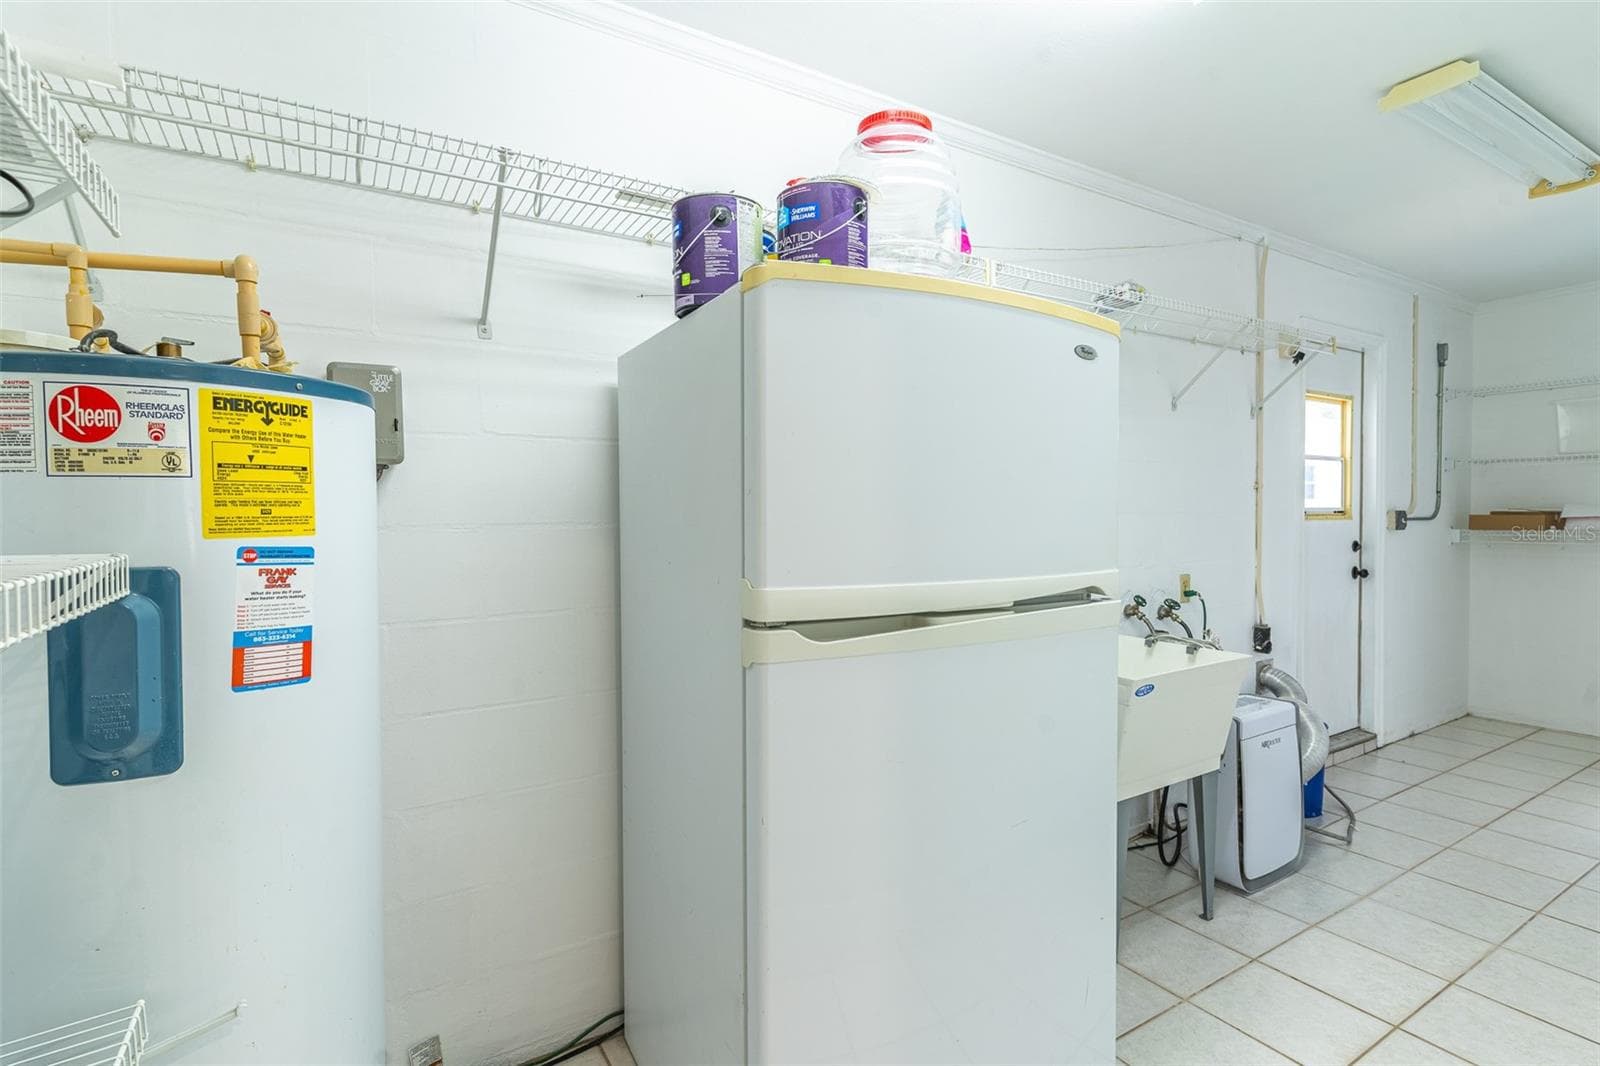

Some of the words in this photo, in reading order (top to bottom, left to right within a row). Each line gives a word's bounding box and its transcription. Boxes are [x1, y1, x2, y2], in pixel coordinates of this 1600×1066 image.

[791, 204, 817, 215] SHERWIN
[790, 212, 817, 222] WILLIAMS
[56, 386, 118, 436] Rheem
[126, 402, 185, 412] RHEEMGLAS
[212, 396, 308, 418] ENERGYGUIDE
[128, 410, 184, 420] STANDARD
[258, 568, 297, 576] FRANK
